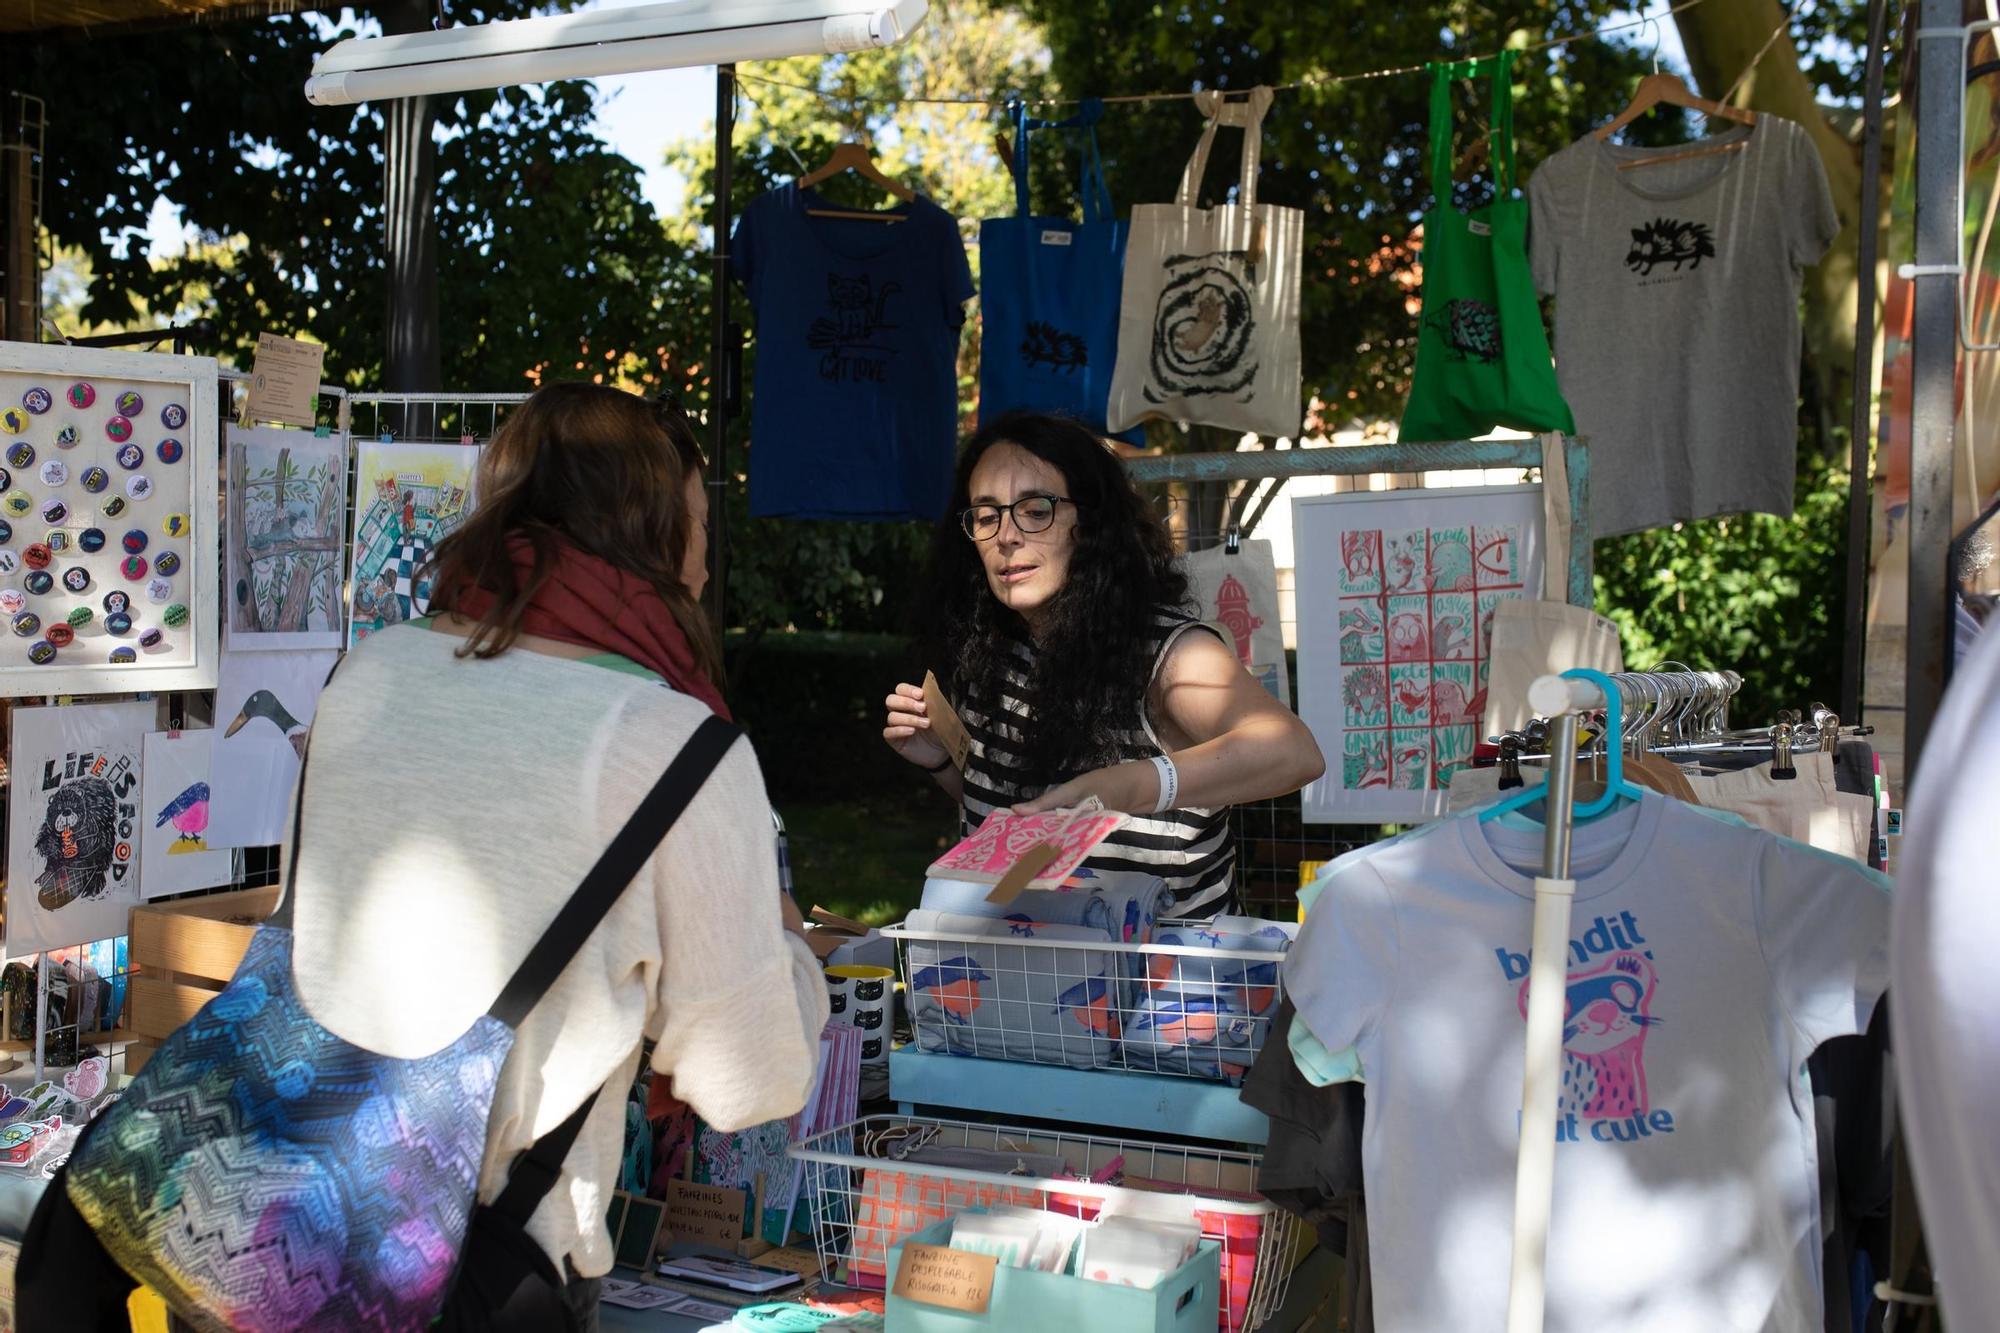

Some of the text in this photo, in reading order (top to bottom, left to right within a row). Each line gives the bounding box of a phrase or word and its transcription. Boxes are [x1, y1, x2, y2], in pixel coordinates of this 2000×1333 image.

[111, 802, 137, 882] FOOD
[1591, 1108, 1675, 1142] cute
[678, 1187, 723, 1205] FANZINES
[912, 1249, 962, 1266] FANZINE
[910, 1264, 976, 1282] DESPLEGABLE
